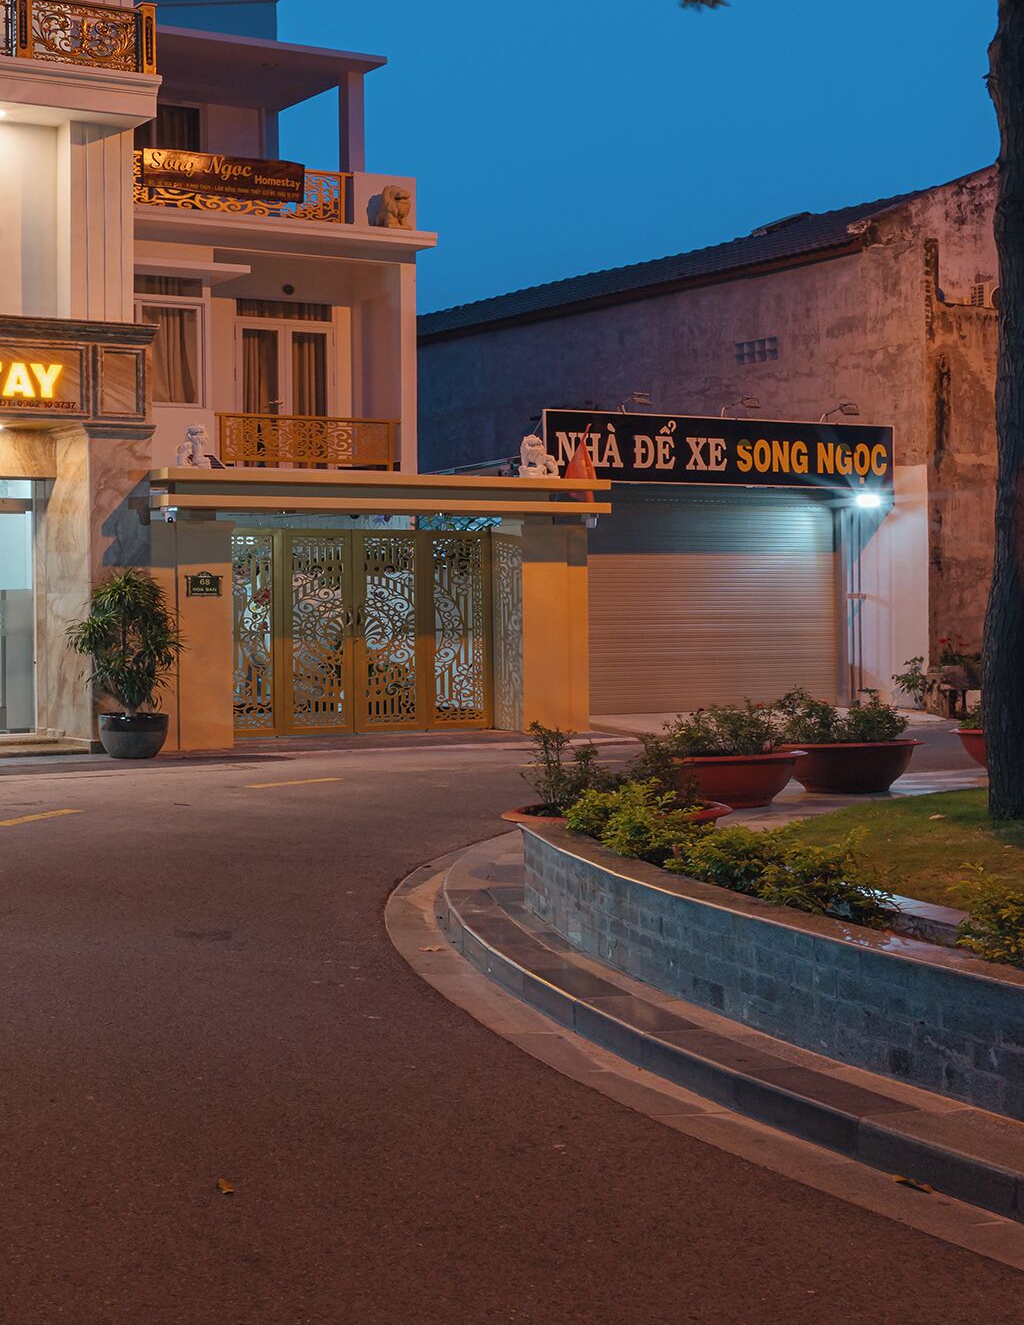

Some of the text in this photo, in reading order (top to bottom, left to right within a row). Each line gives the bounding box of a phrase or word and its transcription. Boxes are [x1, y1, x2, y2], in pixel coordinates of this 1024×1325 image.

[150, 151, 253, 180] Song Ngọc
[254, 174, 301, 191] Homestay
[43, 400, 53, 408] 10
[54, 401, 76, 409] 3737
[555, 420, 888, 485] NHÀ ĐỂ XE SONG NGỌC
